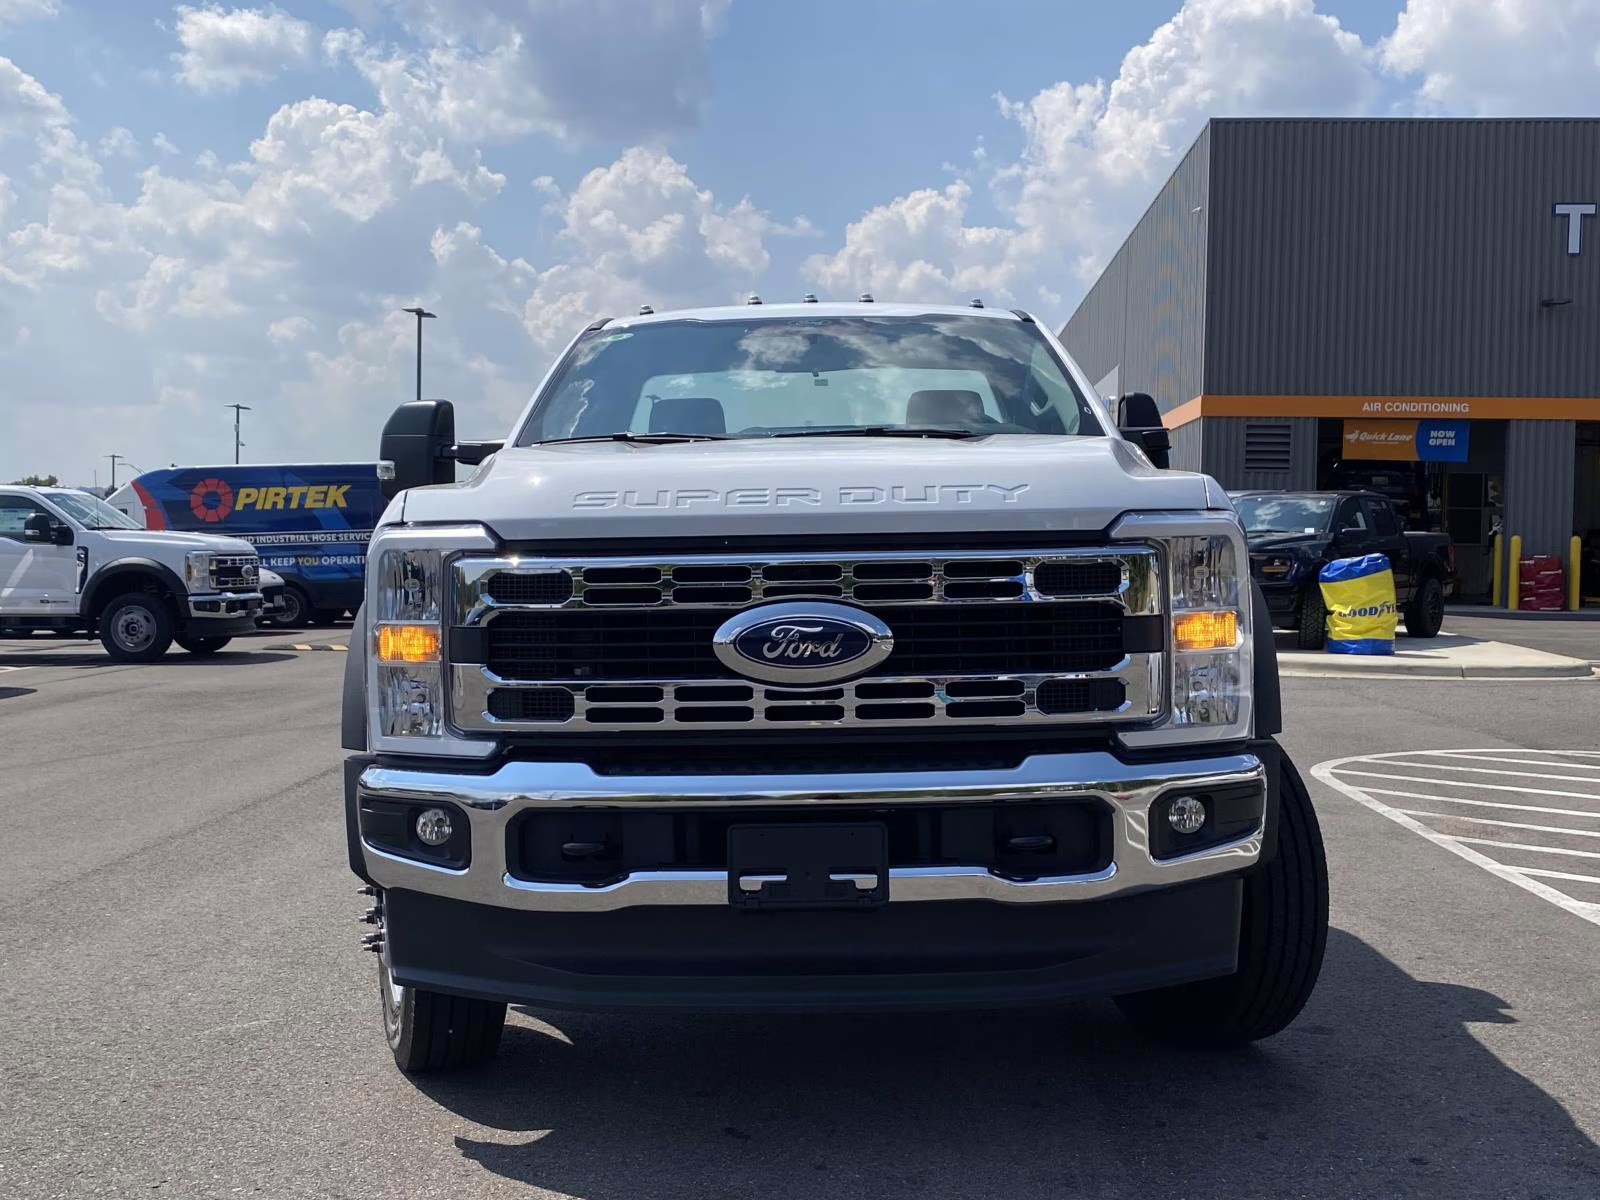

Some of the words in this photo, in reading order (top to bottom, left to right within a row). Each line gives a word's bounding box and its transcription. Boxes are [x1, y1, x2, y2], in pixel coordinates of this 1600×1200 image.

[1553, 203, 1597, 254] T
[1362, 402, 1382, 412] AIR
[1384, 402, 1470, 413] CONDITIONING
[1359, 431, 1387, 441] Quick
[1387, 433, 1413, 441] Lane
[1430, 430, 1456, 438] NOW
[1429, 438, 1456, 446] OPEN
[235, 484, 352, 511] PIRTEK
[572, 487, 822, 510] SUPER
[839, 483, 1031, 506] DUTY
[256, 535, 311, 544] INDUSTRIAL
[312, 533, 339, 542] HOSE
[339, 532, 374, 541] SERVIC
[270, 557, 295, 567] KEEP
[297, 556, 320, 566] YOU
[762, 625, 844, 659] Ford
